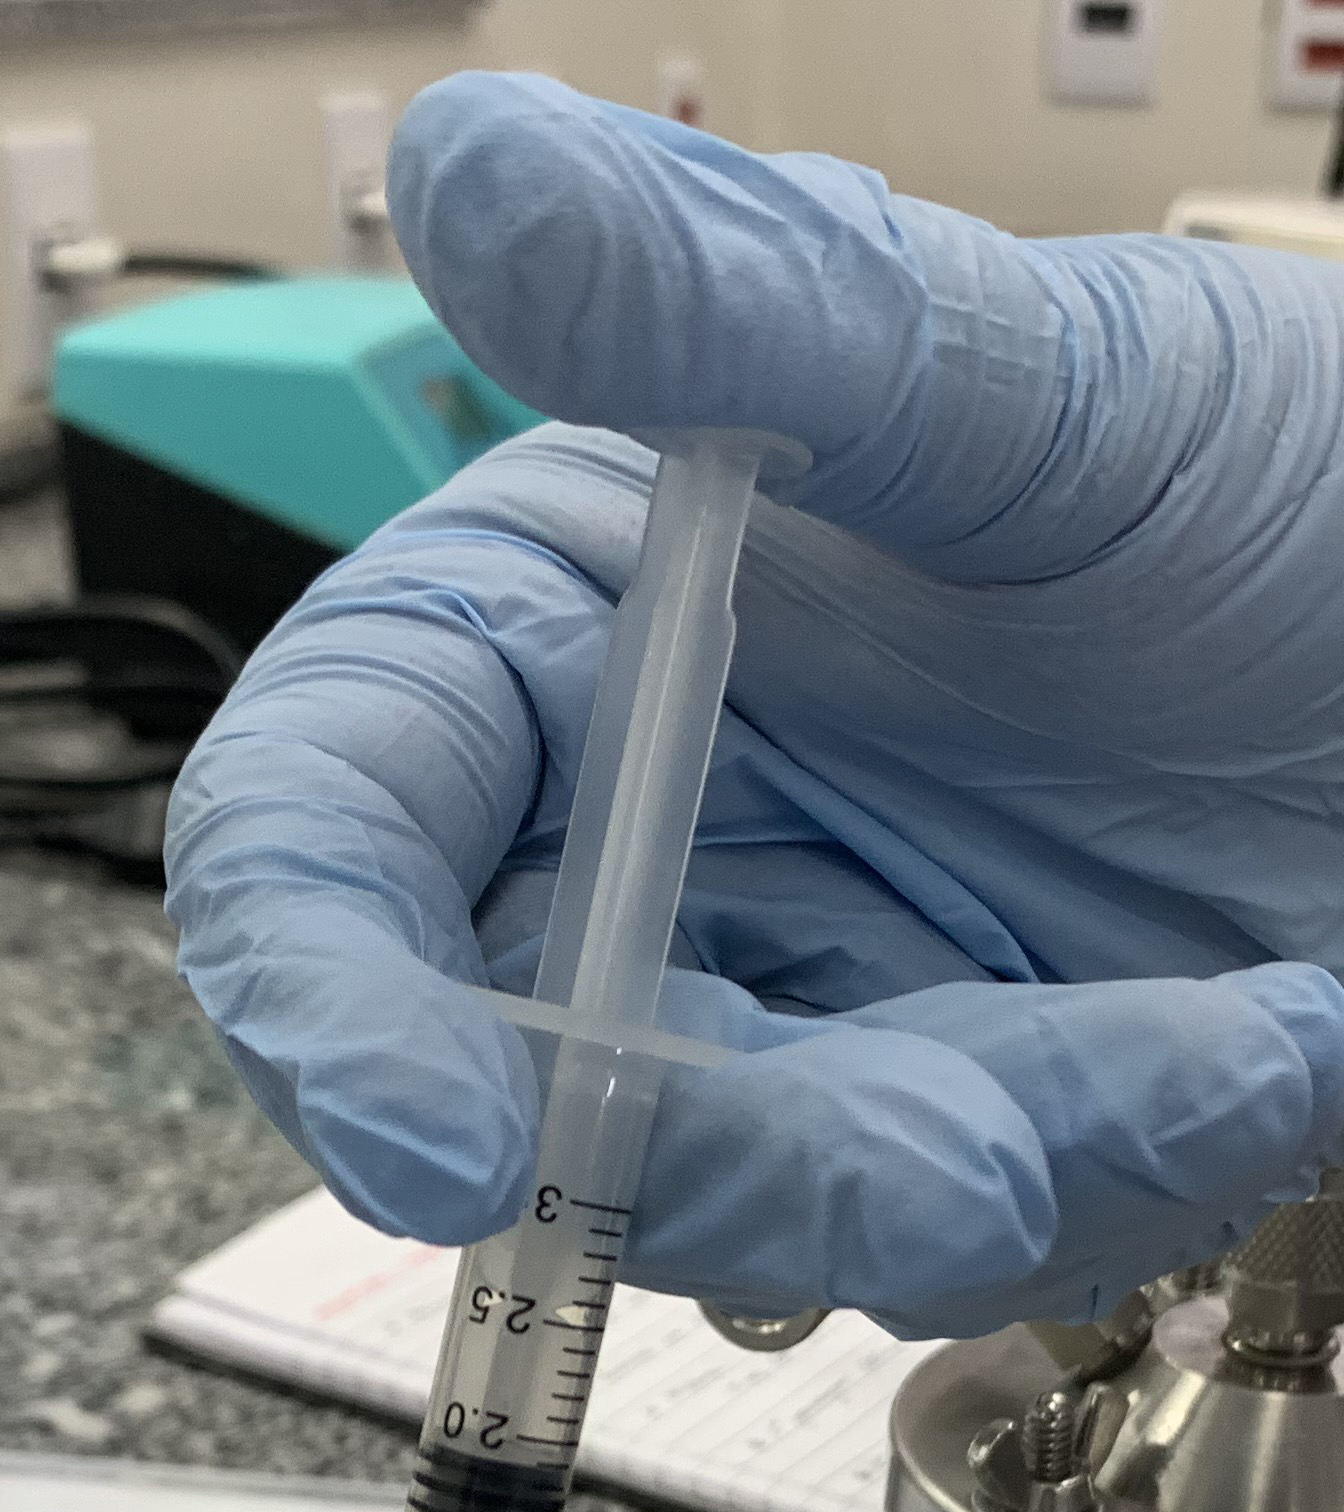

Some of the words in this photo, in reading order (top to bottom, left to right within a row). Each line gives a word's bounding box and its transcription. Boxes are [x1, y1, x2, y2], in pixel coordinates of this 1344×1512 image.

[535, 1185, 562, 1223] 3
[469, 1286, 535, 1333] 2.5
[443, 1401, 509, 1449] 2.0
